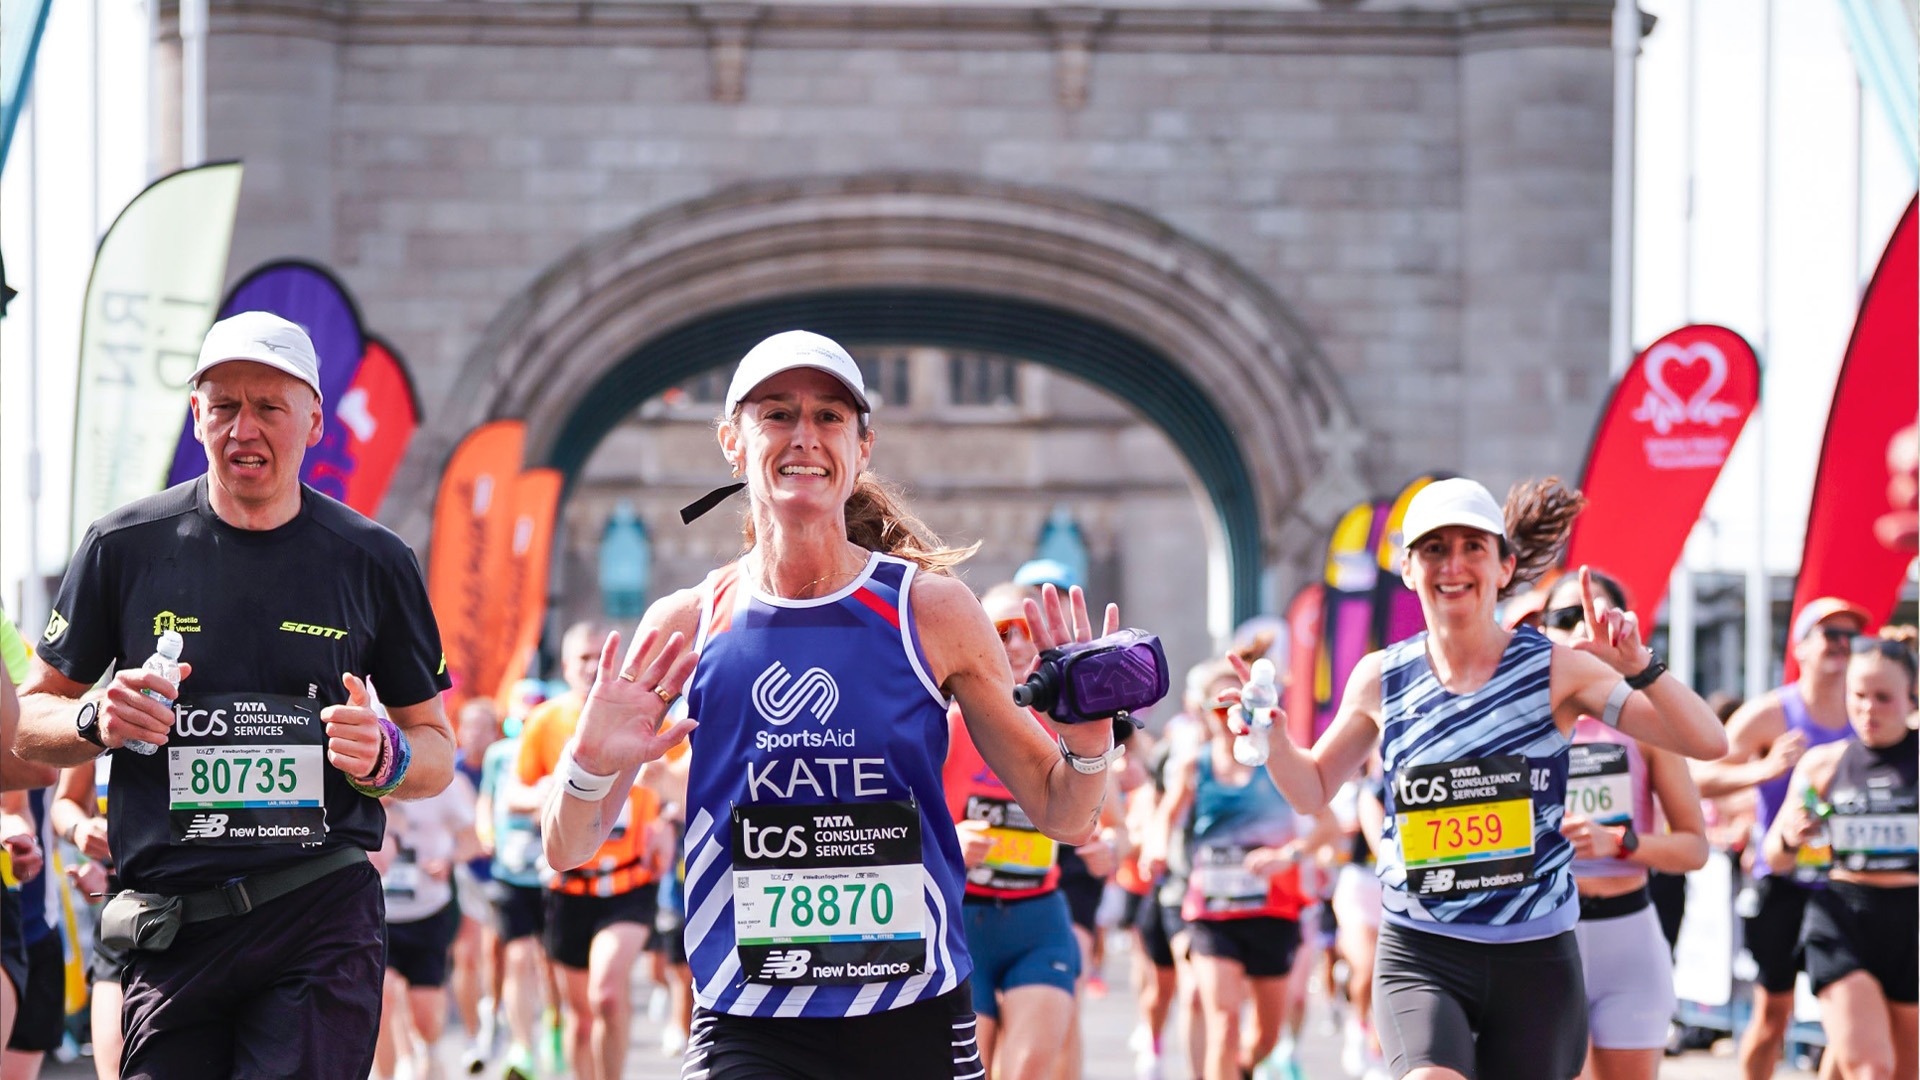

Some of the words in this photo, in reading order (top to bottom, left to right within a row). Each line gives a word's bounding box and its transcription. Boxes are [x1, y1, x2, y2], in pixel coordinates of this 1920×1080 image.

[175, 625, 201, 633] Vertical
[279, 620, 348, 640] SCOTT
[234, 702, 267, 712] TATA
[175, 703, 228, 737] tcs
[233, 714, 310, 726] CONSULTANCY
[233, 726, 284, 736] SERVICES
[755, 729, 855, 753] SportsAid
[190, 757, 297, 795] 80735
[747, 758, 888, 802] KATE
[1449, 765, 1481, 779] TATA
[1451, 772, 1521, 789] CONSULTANCY
[1400, 772, 1448, 806] tcs
[1452, 785, 1498, 800] SERVICES
[813, 815, 854, 828] TATA
[229, 826, 256, 838] new
[257, 825, 310, 838] balance
[743, 818, 808, 859] tcs
[814, 827, 908, 843] CONSULTANCY
[1427, 813, 1503, 851] 7359
[815, 843, 876, 857] SERVICES
[1456, 877, 1481, 890] new
[1481, 872, 1525, 888] balance
[763, 883, 893, 928] 78870
[812, 965, 847, 978] new
[847, 962, 910, 977] balance
